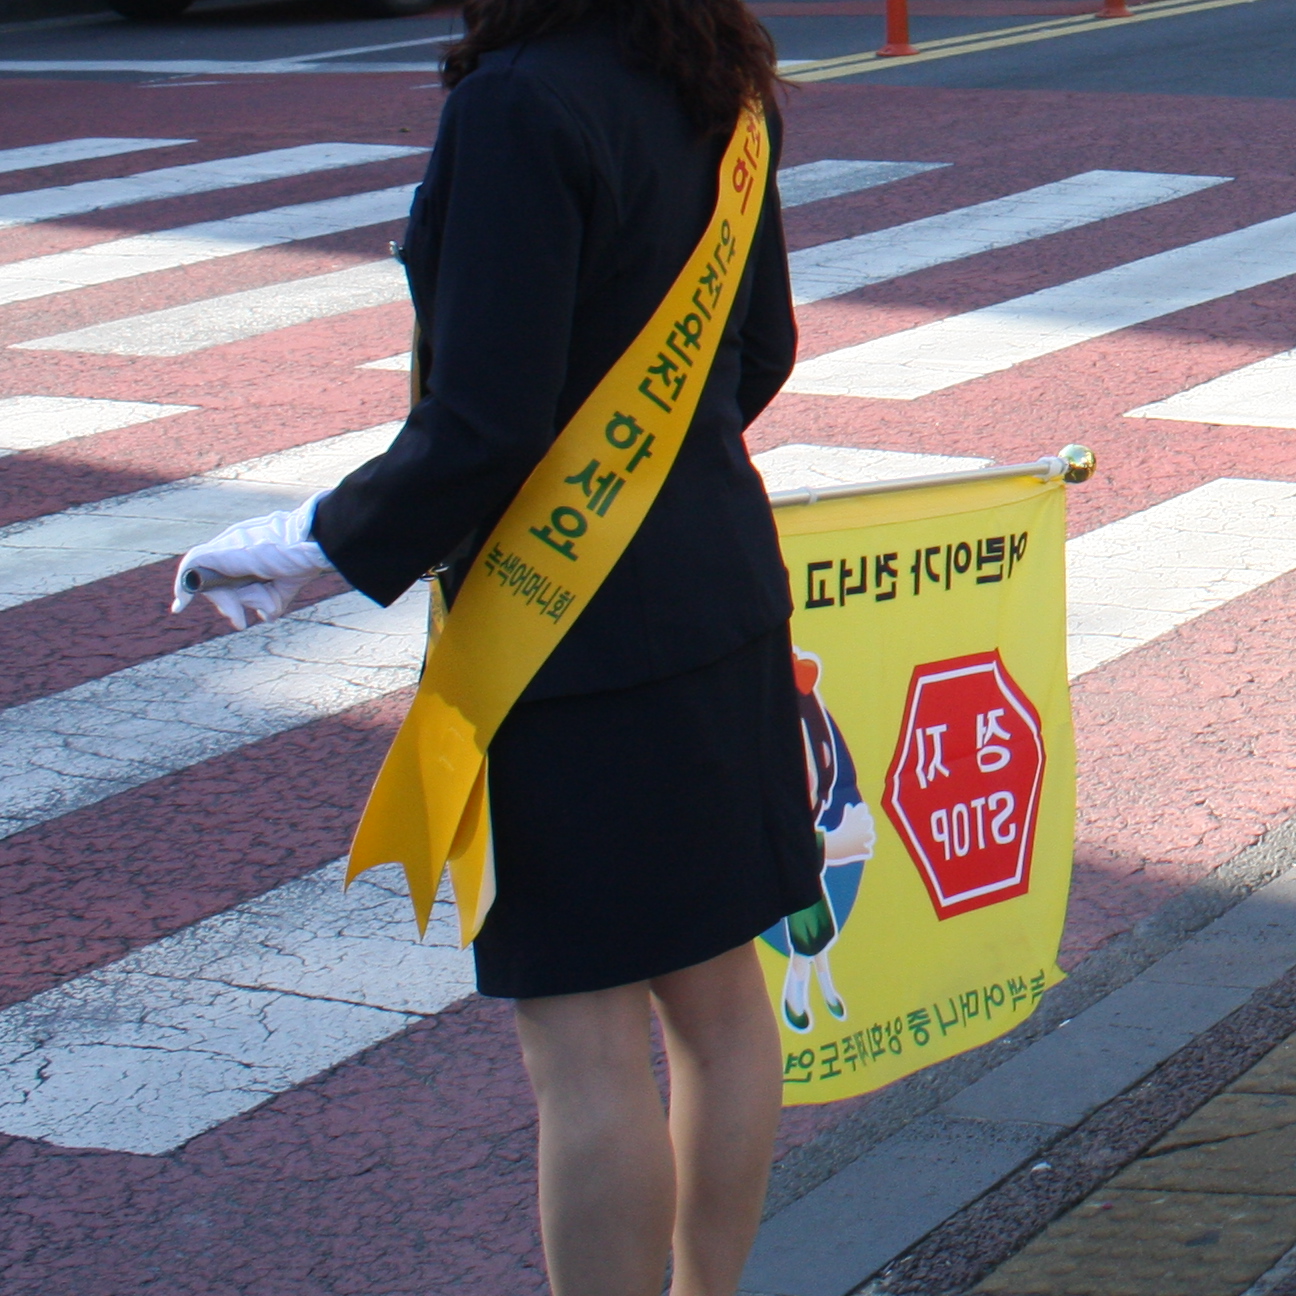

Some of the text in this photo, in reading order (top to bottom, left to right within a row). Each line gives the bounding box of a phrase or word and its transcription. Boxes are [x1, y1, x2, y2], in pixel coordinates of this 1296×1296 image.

[639, 216, 738, 415] 안전운전
[529, 408, 656, 564] 하세요
[484, 542, 576, 627] 녹색어머니회
